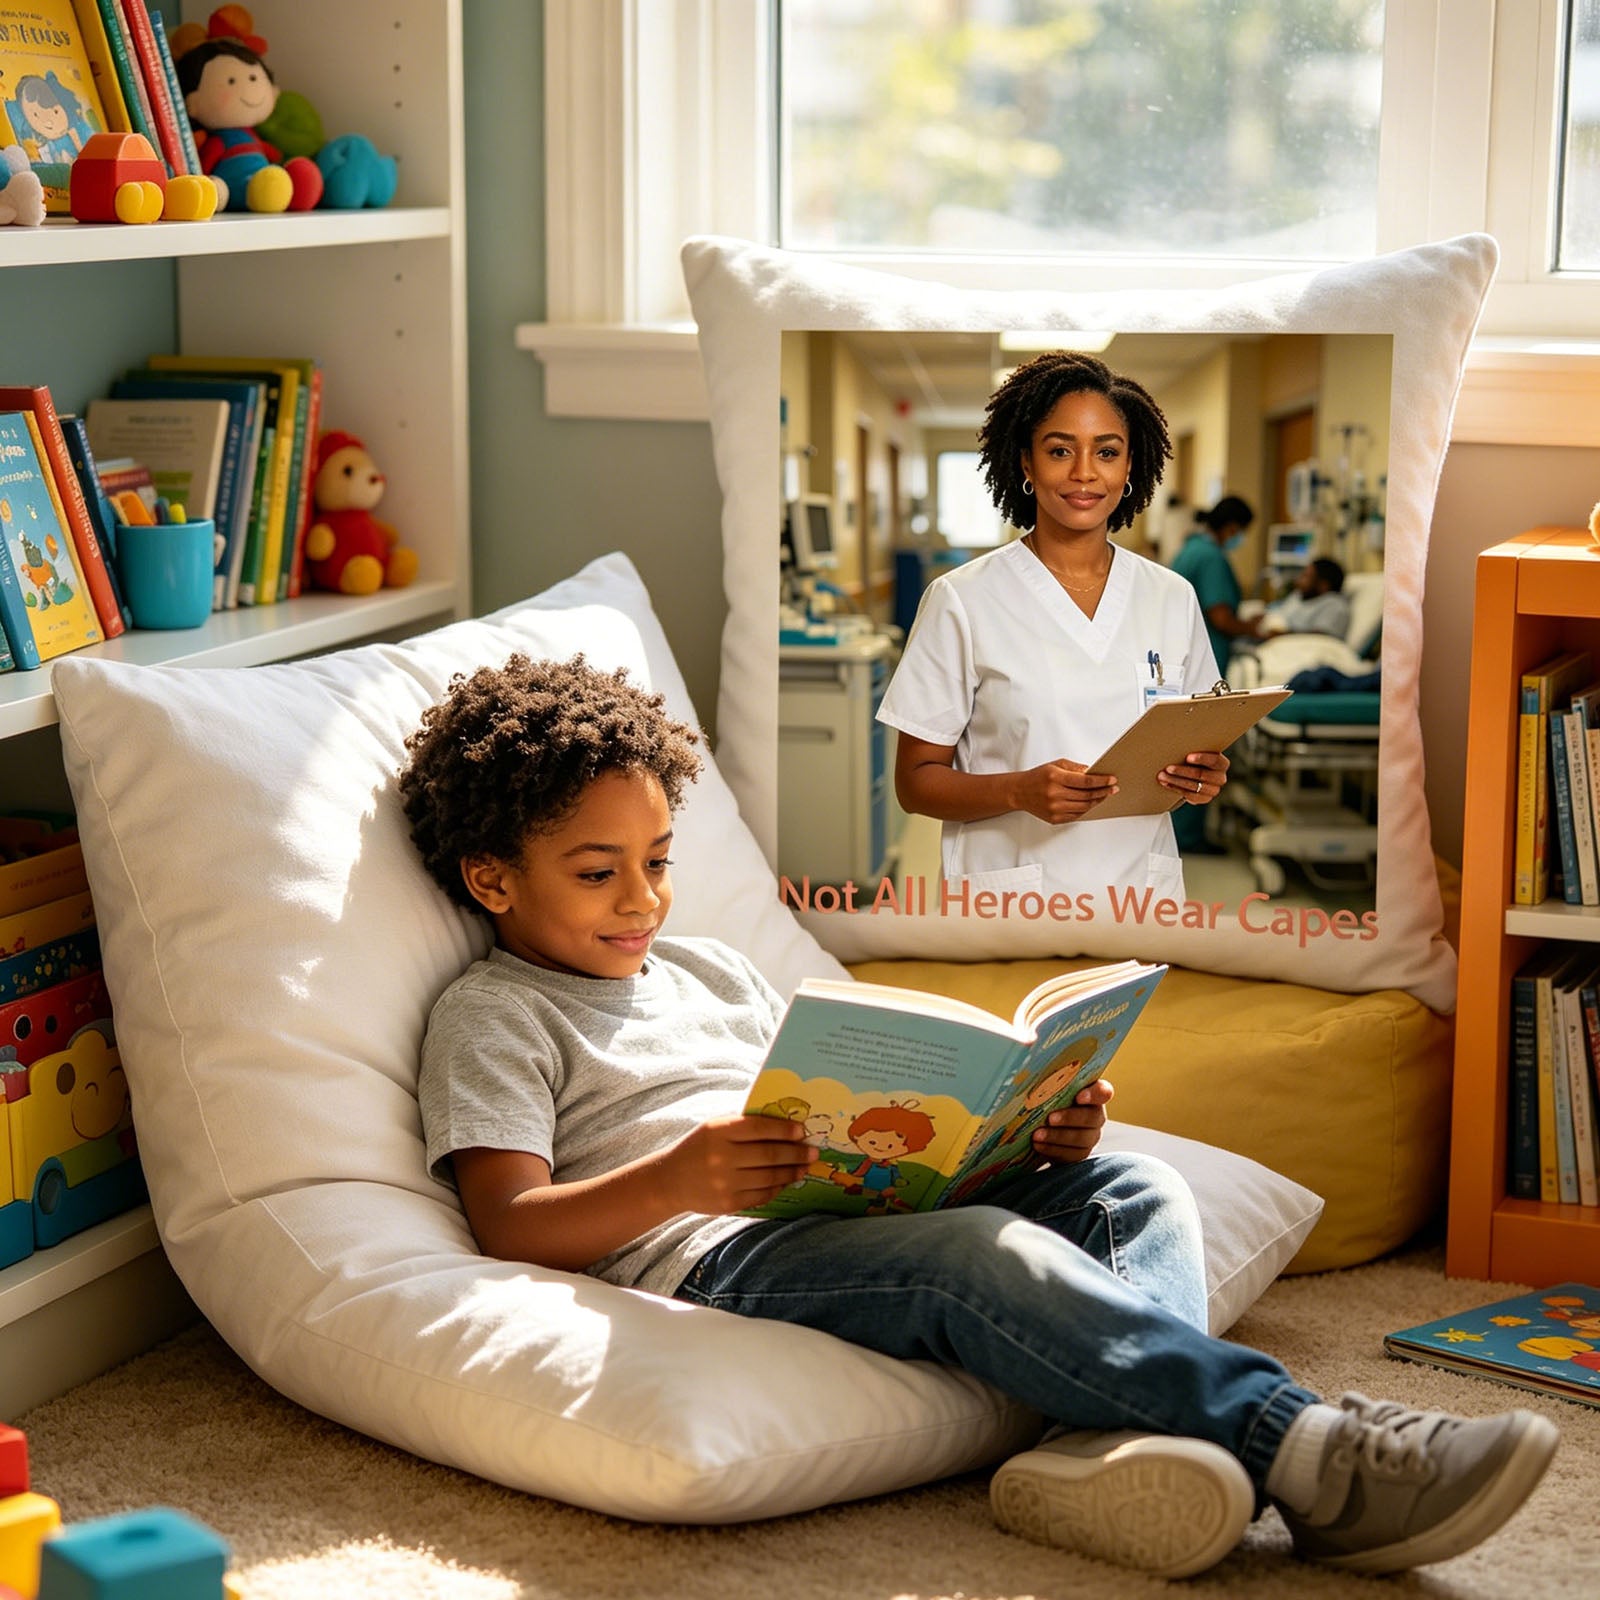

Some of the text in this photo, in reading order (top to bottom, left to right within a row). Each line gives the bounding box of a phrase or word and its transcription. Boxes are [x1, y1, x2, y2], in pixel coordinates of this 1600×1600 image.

[779, 875, 1380, 948] Not All Heroes Wear Capes
